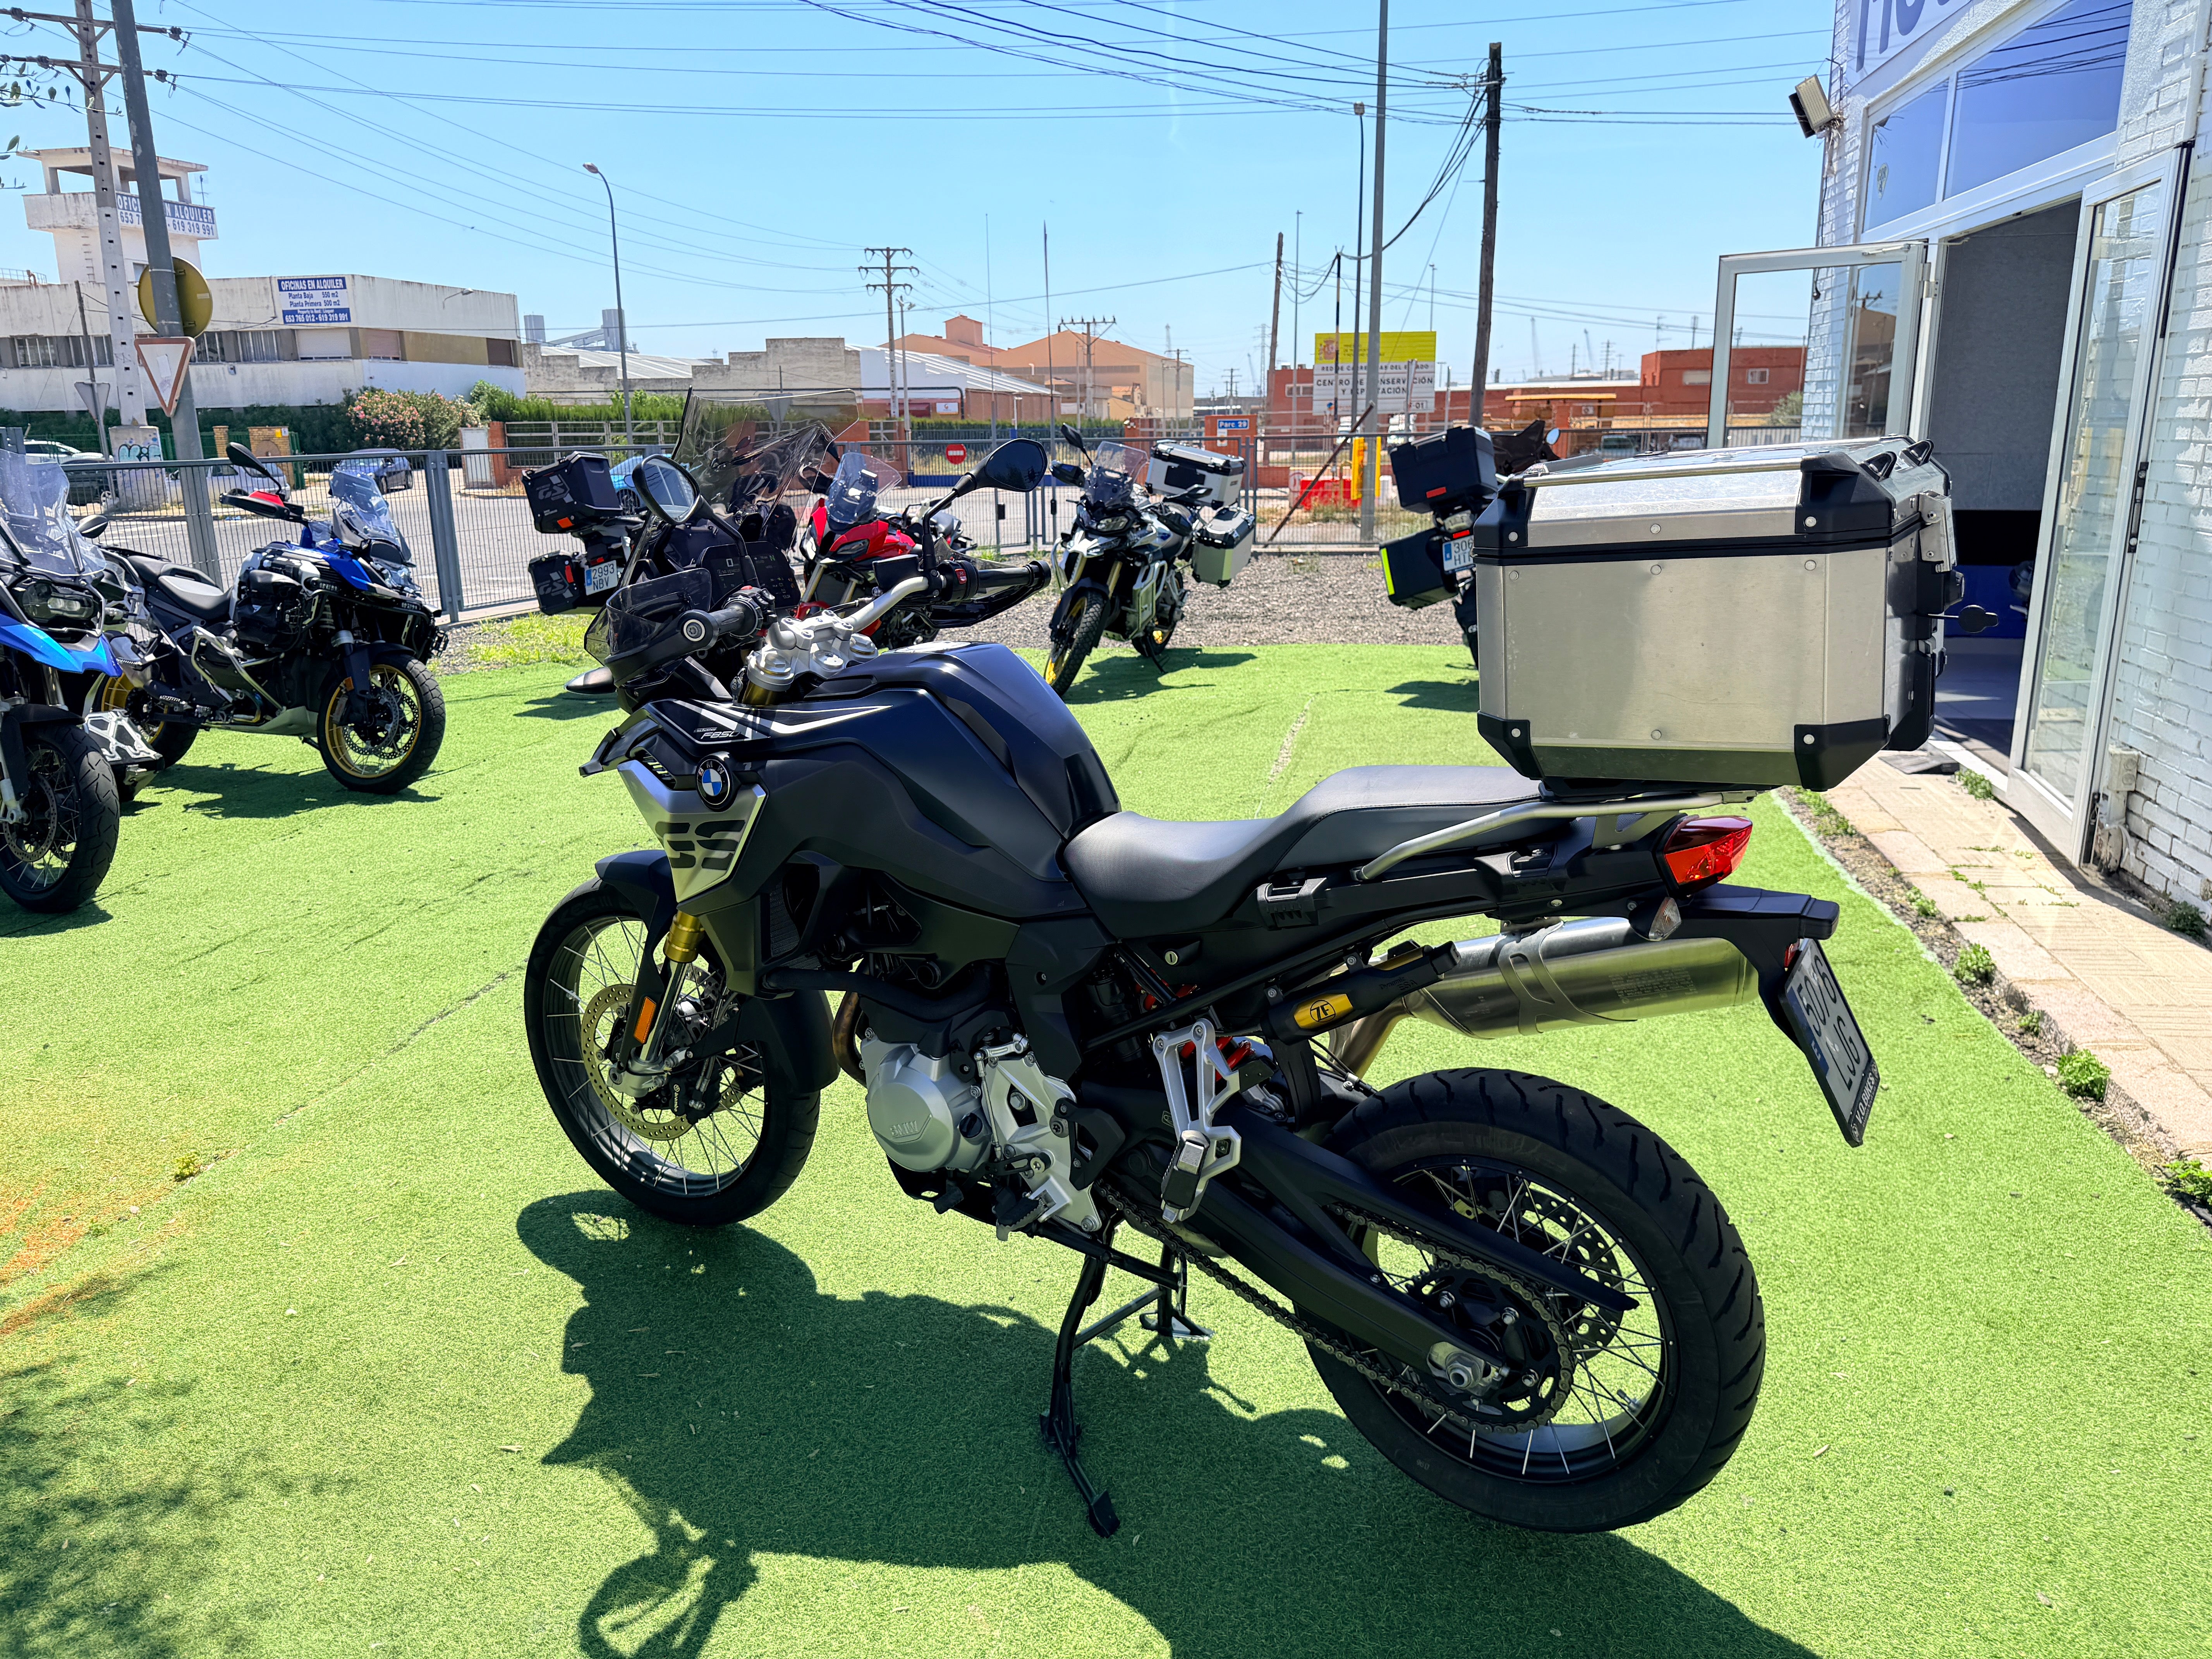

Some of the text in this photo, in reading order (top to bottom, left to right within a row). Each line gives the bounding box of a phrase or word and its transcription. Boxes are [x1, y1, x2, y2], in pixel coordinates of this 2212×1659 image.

[117, 194, 141, 212] OFICI
[175, 205, 213, 223] ALQUILER
[120, 211, 134, 224] 653
[172, 219, 214, 236] 619 319 991
[281, 278, 343, 290] OFICINAS EN ALQUILER
[305, 314, 315, 322] 012
[318, 313, 328, 321] 619
[329, 313, 338, 321] 319
[338, 313, 348, 321] 991
[1453, 538, 1473, 554] 306
[592, 563, 615, 580] 2993
[593, 576, 610, 591] NBV
[698, 761, 725, 776] BMW
[1379, 977, 1405, 989] Dynamic
[1311, 1002, 1336, 1022] ZF
[1811, 1039, 1821, 1061] E
[1826, 1015, 1860, 1092] LJG
[890, 1120, 918, 1135] BMW
